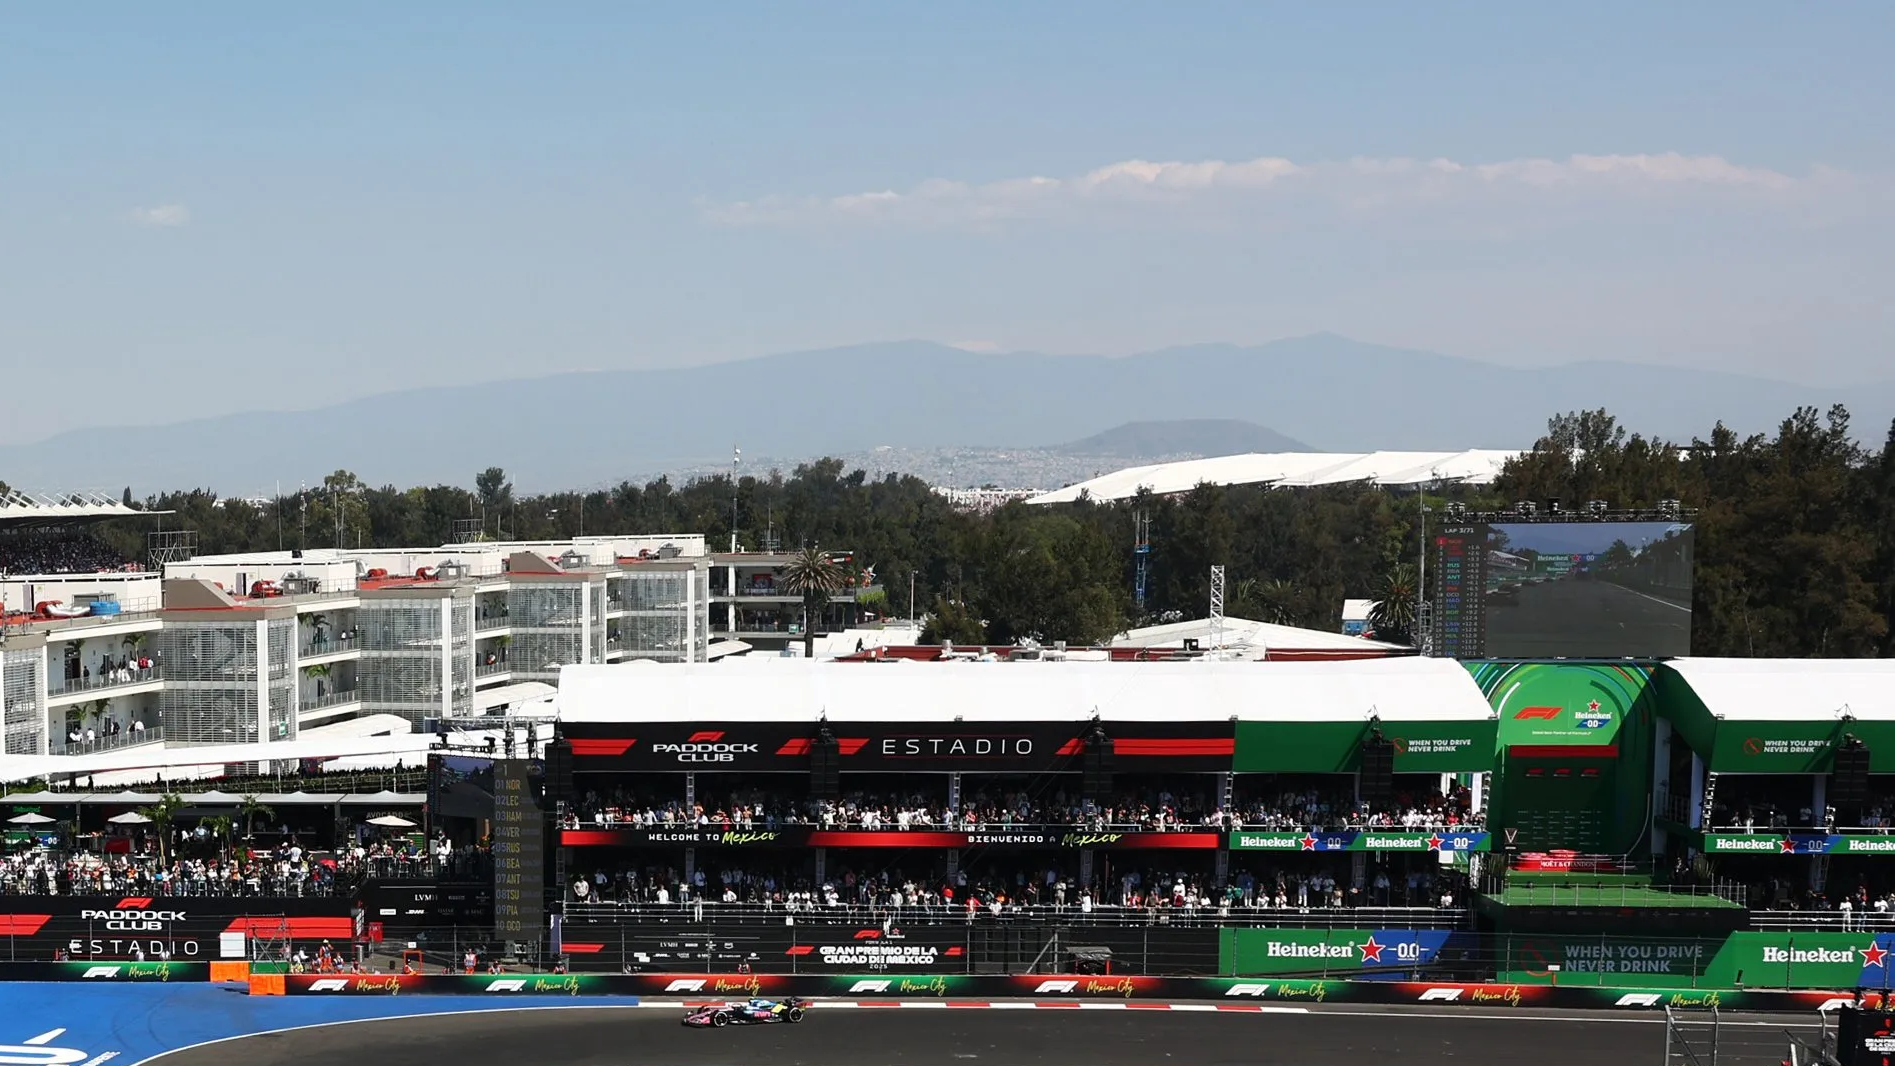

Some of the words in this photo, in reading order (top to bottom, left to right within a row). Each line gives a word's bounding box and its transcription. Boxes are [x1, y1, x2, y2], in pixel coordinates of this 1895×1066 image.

[1575, 711, 1611, 719] Heineken
[652, 743, 759, 754] PADDOCK
[882, 738, 1034, 755] ESTADIO
[677, 753, 735, 762] CLUB
[648, 833, 701, 842] WELCOME
[705, 833, 720, 842] TO
[721, 830, 783, 845] Mexico
[968, 834, 1044, 843] BIENVENIDO
[1061, 831, 1123, 848] Mexico
[1240, 836, 1293, 848] Heineken
[1366, 837, 1419, 848] Heineken
[1716, 839, 1774, 850] Heineken
[81, 910, 186, 921] PADDOCK
[106, 921, 163, 931] CLUB
[69, 939, 199, 955] ESTADIO
[819, 946, 855, 955] GRAN
[904, 946, 920, 955] DE
[921, 946, 938, 955] LA
[1267, 941, 1352, 959] Heineken
[1565, 945, 1612, 958] WHEN
[1619, 945, 1658, 958] YOU
[1662, 945, 1703, 958] DRIVE
[1763, 946, 1853, 963] Heineken
[824, 956, 867, 964] CIUDAD
[1565, 960, 1612, 972] NEVER
[1616, 960, 1671, 972] DRINK
[129, 964, 154, 977] Mexico
[155, 962, 170, 981] City
[357, 977, 384, 992] Mexico
[385, 976, 400, 995] City
[535, 977, 562, 992] Mexico
[563, 976, 580, 995] City
[715, 978, 743, 992] Mexico
[744, 976, 761, 995] City
[901, 979, 928, 993] Mexico
[929, 977, 947, 996] City
[1087, 979, 1116, 994] Mexico
[1117, 977, 1135, 996] City
[1277, 982, 1308, 997] Mexico
[1309, 980, 1327, 1002] City
[1472, 986, 1503, 1001] Mexico
[1504, 985, 1522, 1008] City
[1671, 992, 1702, 1007] Mexico
[1703, 990, 1722, 1013] City
